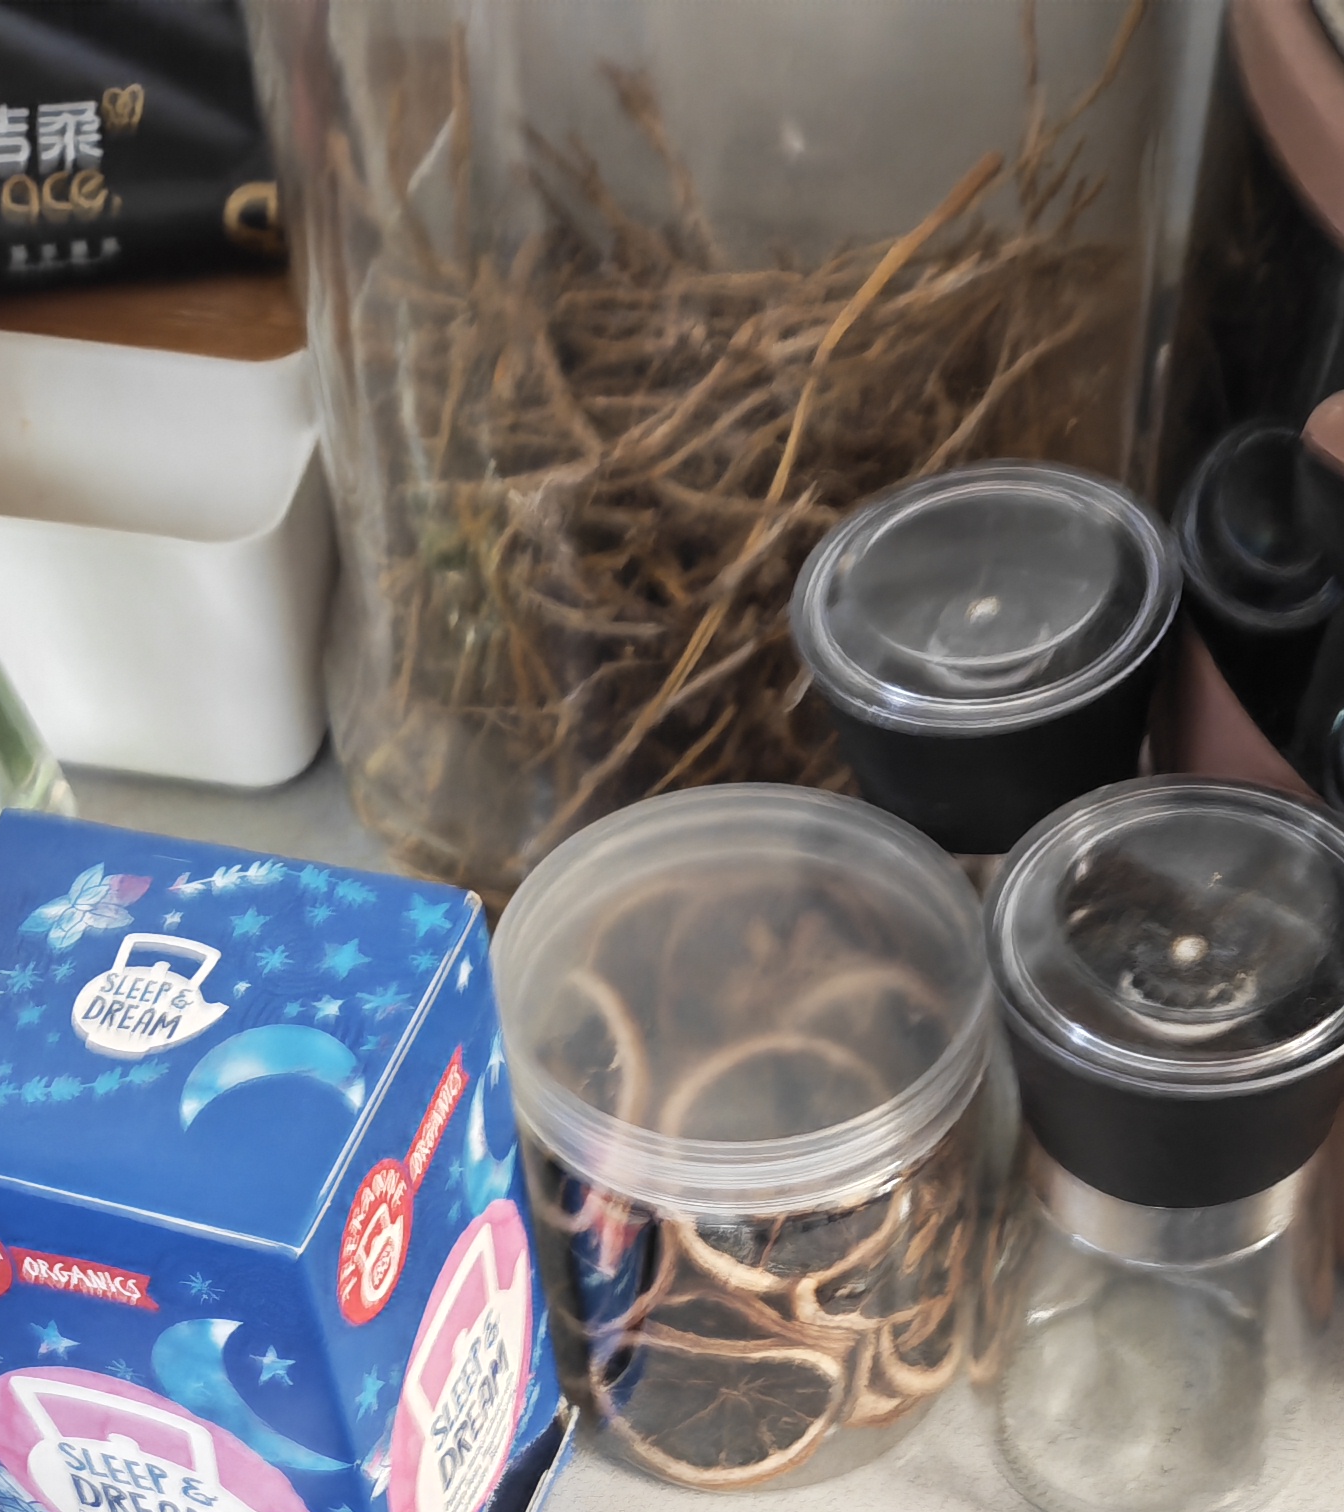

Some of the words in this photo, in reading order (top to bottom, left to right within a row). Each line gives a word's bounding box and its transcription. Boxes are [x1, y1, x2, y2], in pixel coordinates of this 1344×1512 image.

[81, 995, 182, 1039] DREAM
[100, 972, 173, 1005] SLEEP
[171, 988, 194, 1010] &
[22, 1255, 143, 1301] ORGANICS
[430, 1336, 482, 1452] SLEEP
[438, 1337, 509, 1494] DREAM
[58, 1441, 168, 1495] SLEEP
[182, 1476, 218, 1508] &
